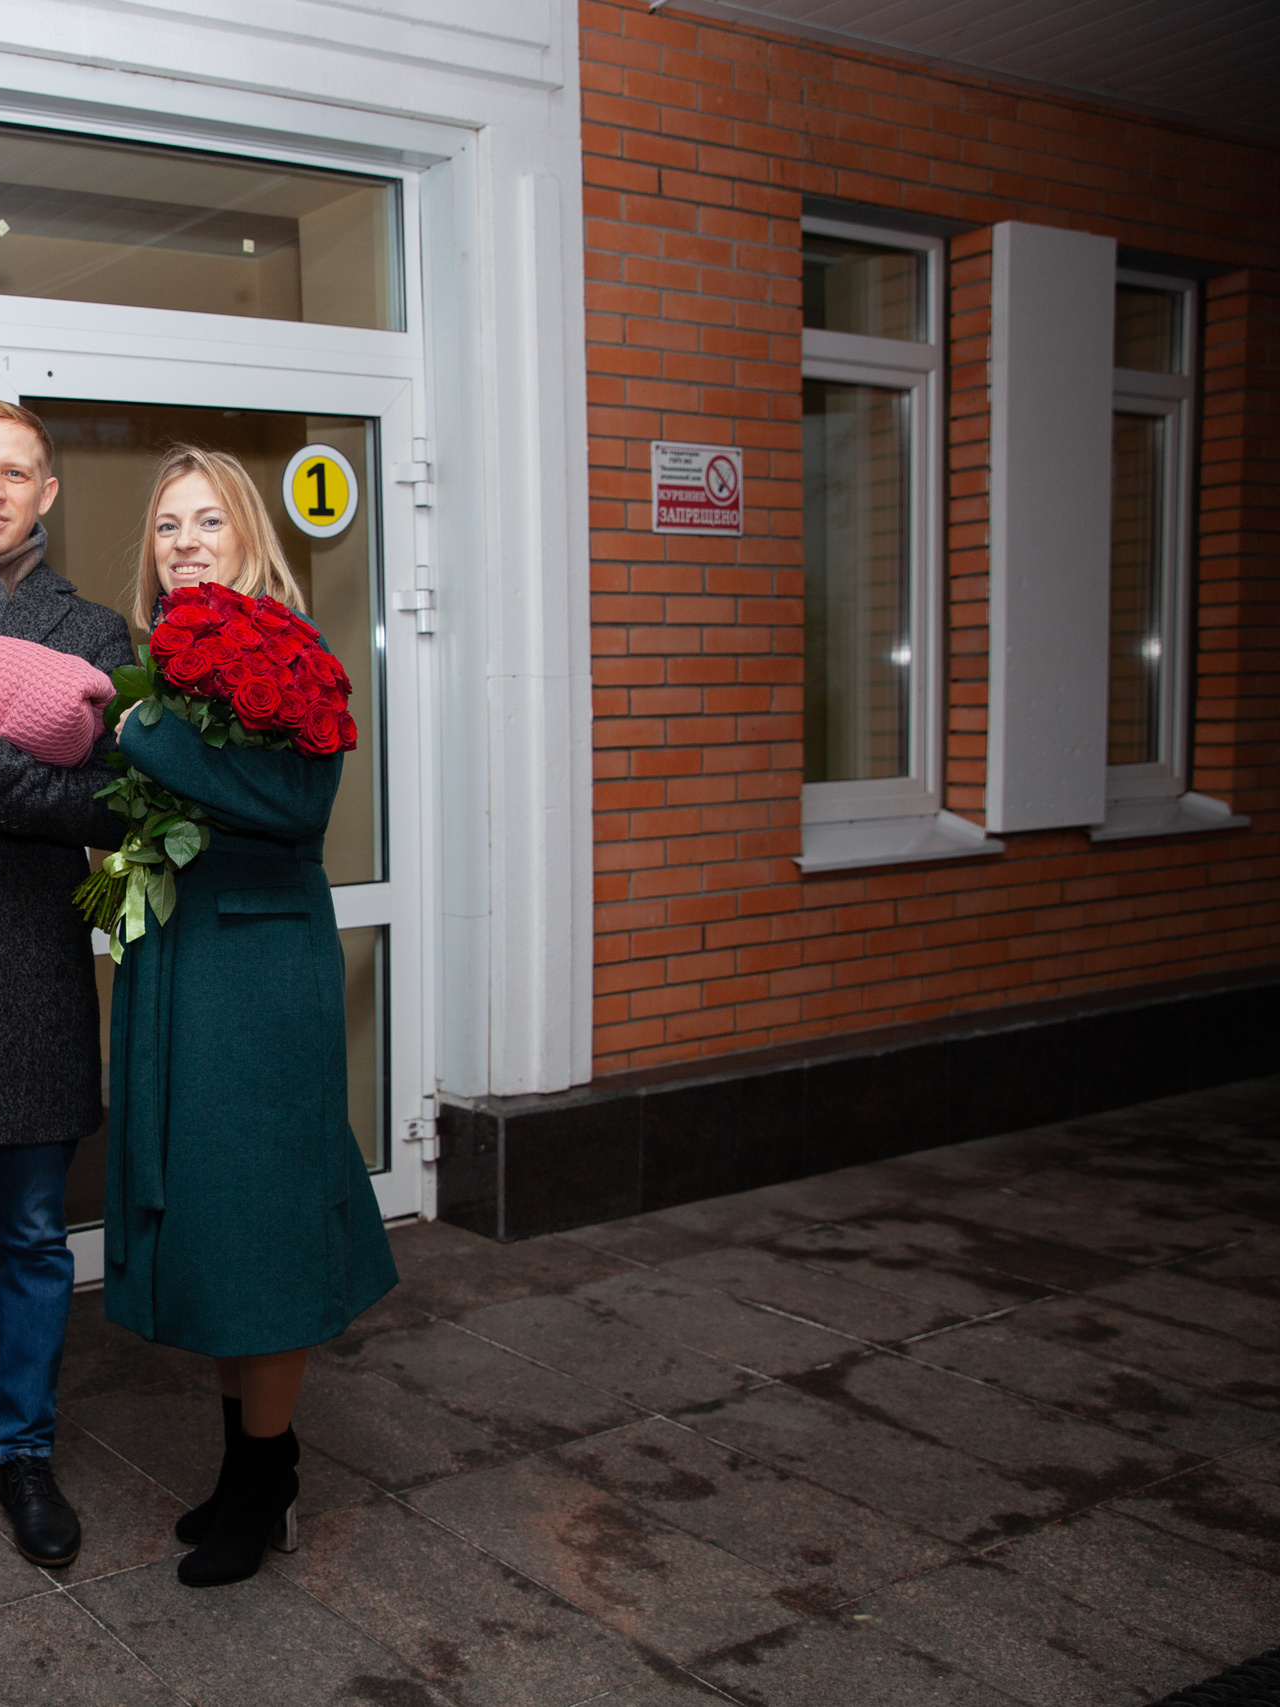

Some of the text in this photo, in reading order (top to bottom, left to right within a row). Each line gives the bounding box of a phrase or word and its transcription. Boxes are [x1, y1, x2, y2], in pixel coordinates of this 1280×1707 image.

[307, 463, 335, 516] 1
[658, 488, 708, 503] КУРЕНИЕ
[658, 505, 739, 527] ЗАПРЕЩЕНО
